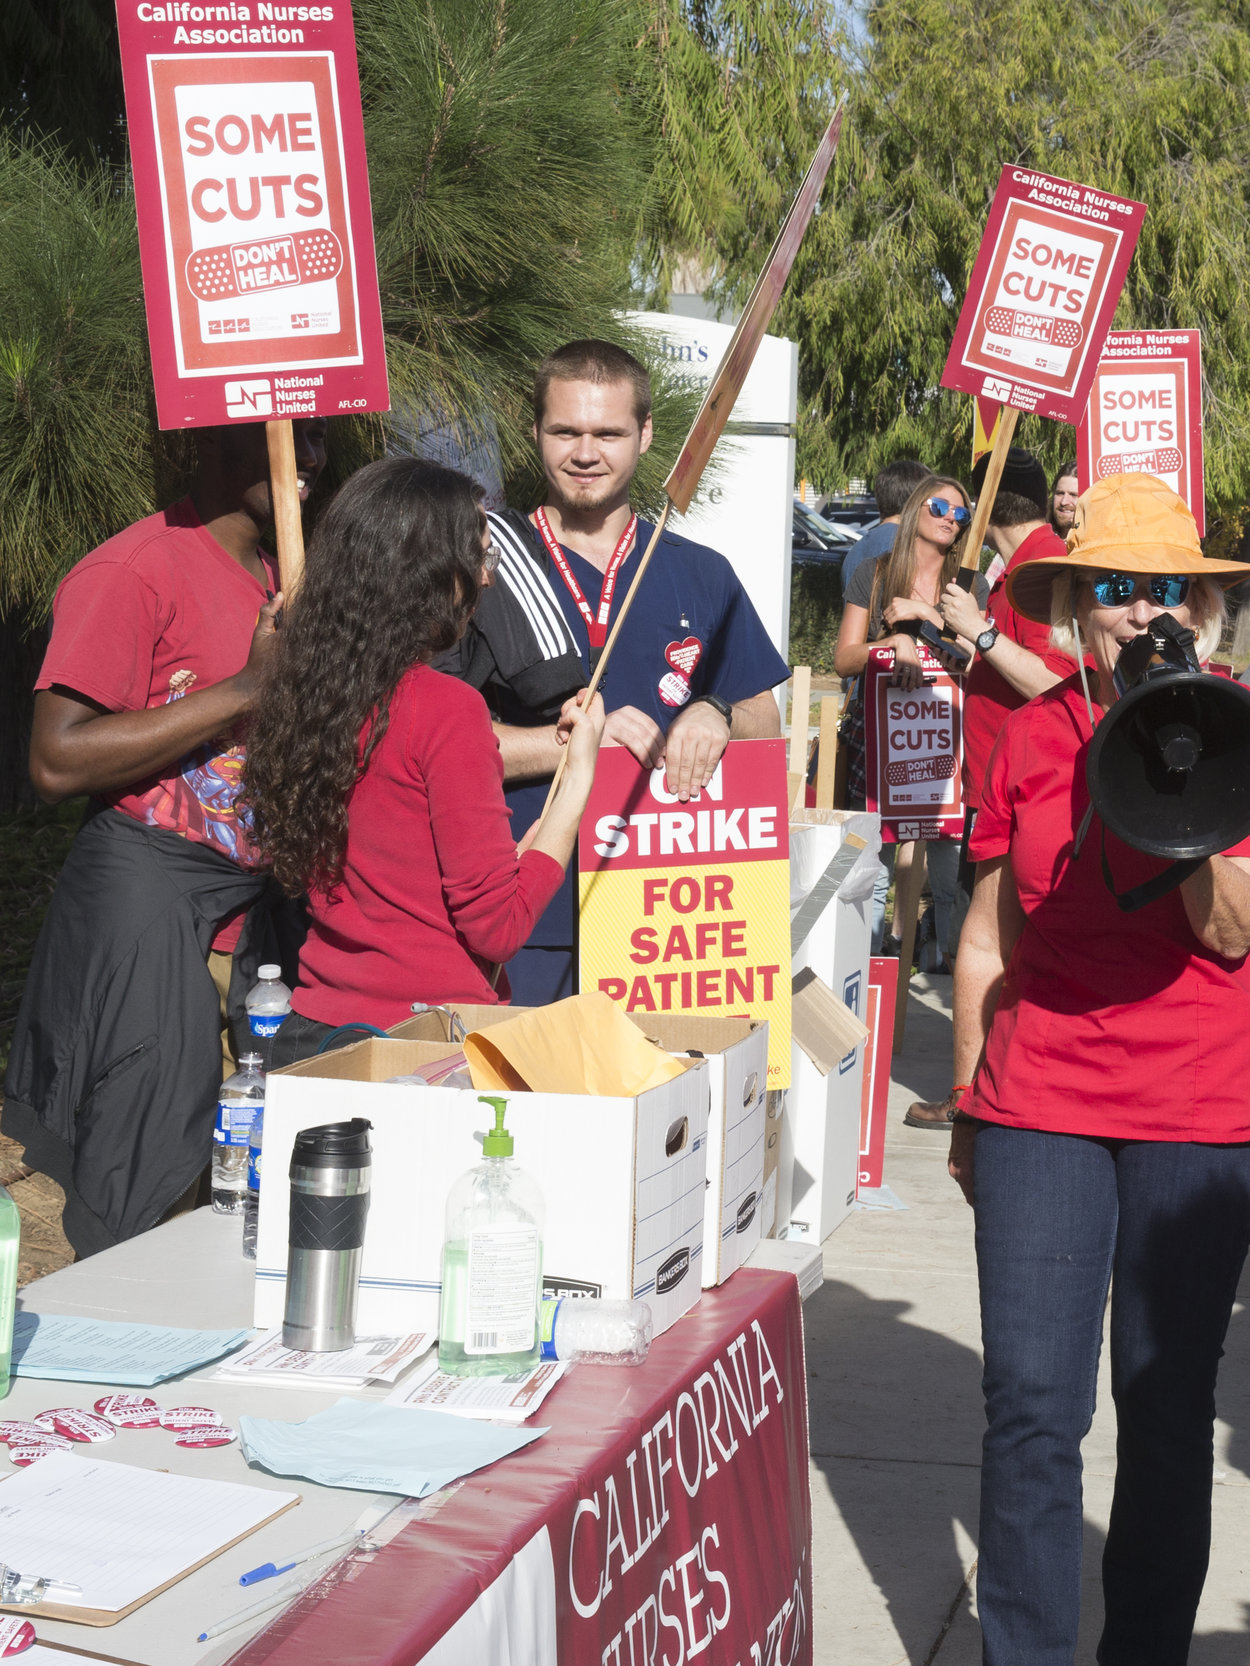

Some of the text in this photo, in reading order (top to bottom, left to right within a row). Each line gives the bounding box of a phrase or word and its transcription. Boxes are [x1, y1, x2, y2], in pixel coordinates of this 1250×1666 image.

[137, 2, 334, 22] California Nurses
[173, 25, 304, 44] Association
[185, 112, 316, 157] SOME
[191, 173, 323, 223] CUTS
[1012, 170, 1133, 216] California Nurses
[1028, 188, 1110, 221] Association
[233, 241, 292, 267] DON'T
[1012, 238, 1095, 280] SOME
[239, 263, 297, 289] HEAL
[1002, 272, 1085, 314] CUTS
[1015, 312, 1053, 329] DON'T
[1013, 325, 1050, 342] HEAL
[1105, 334, 1189, 345] fornia Nurses
[1102, 345, 1172, 356] Association
[274, 374, 324, 389] National
[275, 389, 316, 401] Nurses
[1012, 392, 1037, 404] Nurses
[1014, 385, 1046, 400] National
[1103, 389, 1172, 410] SOME
[276, 400, 316, 414] United
[338, 399, 367, 409] AFL-CIO
[1010, 398, 1036, 411] United
[1048, 410, 1067, 420] AFL-CIO
[1103, 420, 1174, 442] CUTS
[1123, 452, 1154, 465] DON'T
[667, 676, 690, 698] STRIKE
[889, 701, 950, 720] SOME
[890, 729, 950, 750] CUTS
[907, 759, 934, 771] DON'T
[908, 770, 935, 781] HEAL
[593, 806, 778, 859] STRIKE
[643, 875, 734, 917] FOR
[629, 920, 747, 965] SAFE
[597, 964, 780, 1014] PATIENT
[258, 1024, 280, 1036] Spar
[112, 1406, 161, 1416] STRIKE
[60, 1413, 101, 1438] STRIKE
[179, 1428, 232, 1436] STRIKE
[569, 1318, 784, 1618] CALIFORNIA
